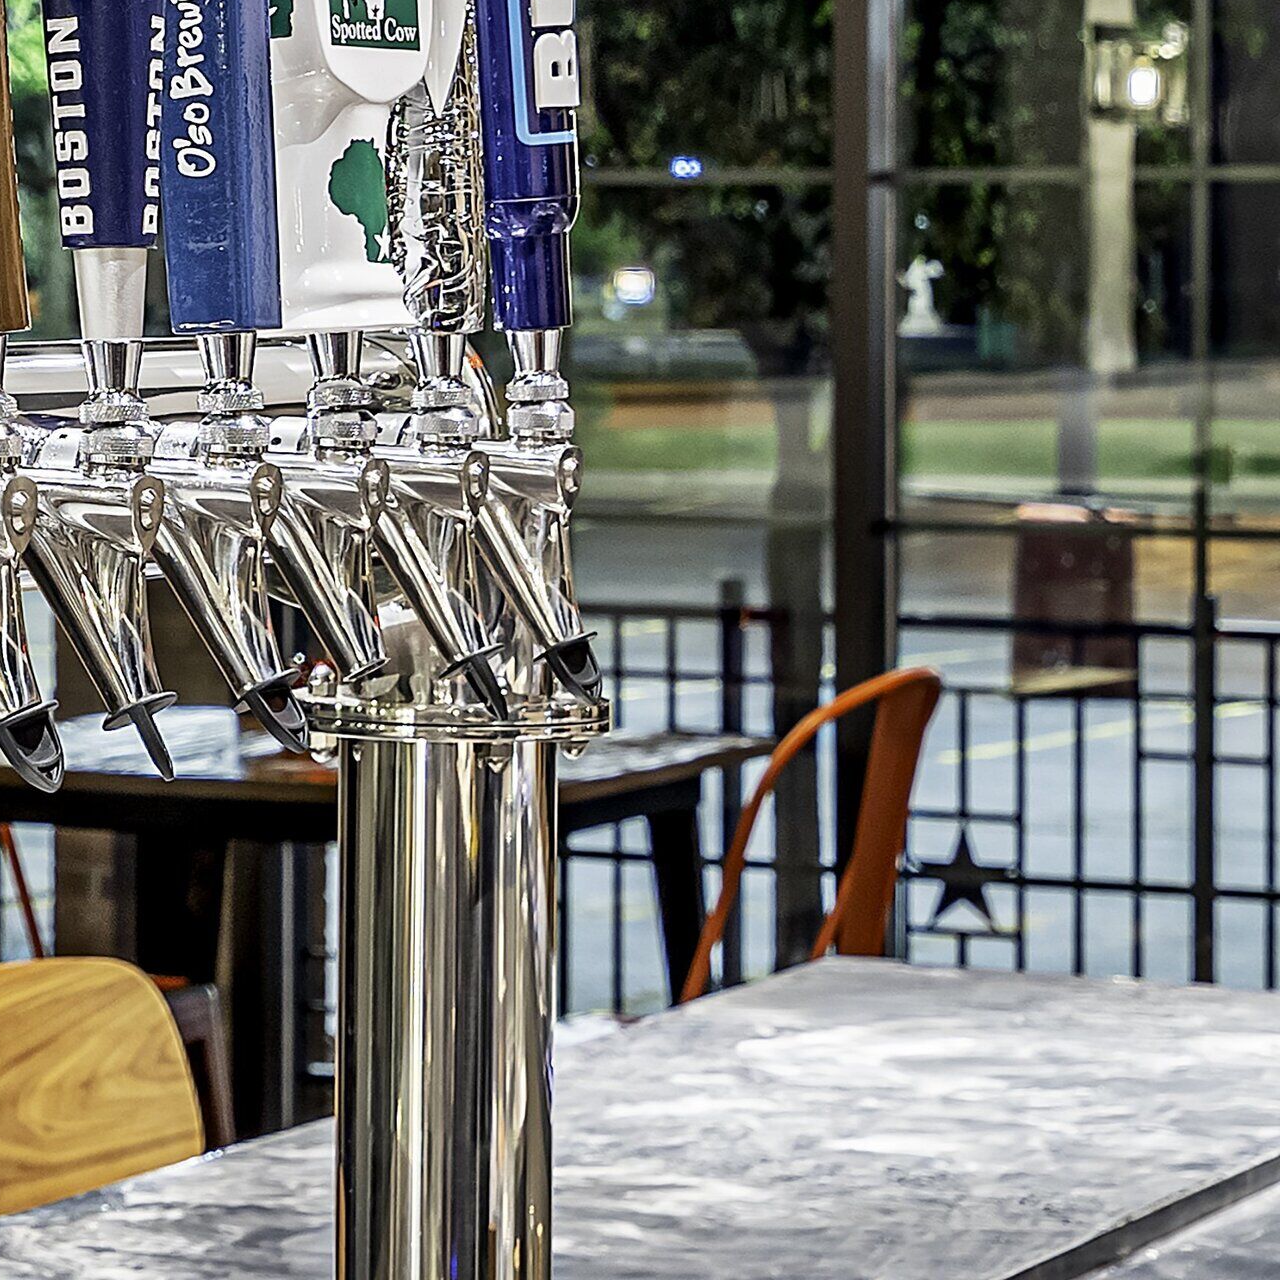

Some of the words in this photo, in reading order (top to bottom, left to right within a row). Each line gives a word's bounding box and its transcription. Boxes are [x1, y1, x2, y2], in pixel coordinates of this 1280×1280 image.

[331, 13, 382, 44] Spotted
[383, 16, 417, 42] Cow
[47, 16, 94, 236] BOSTON
